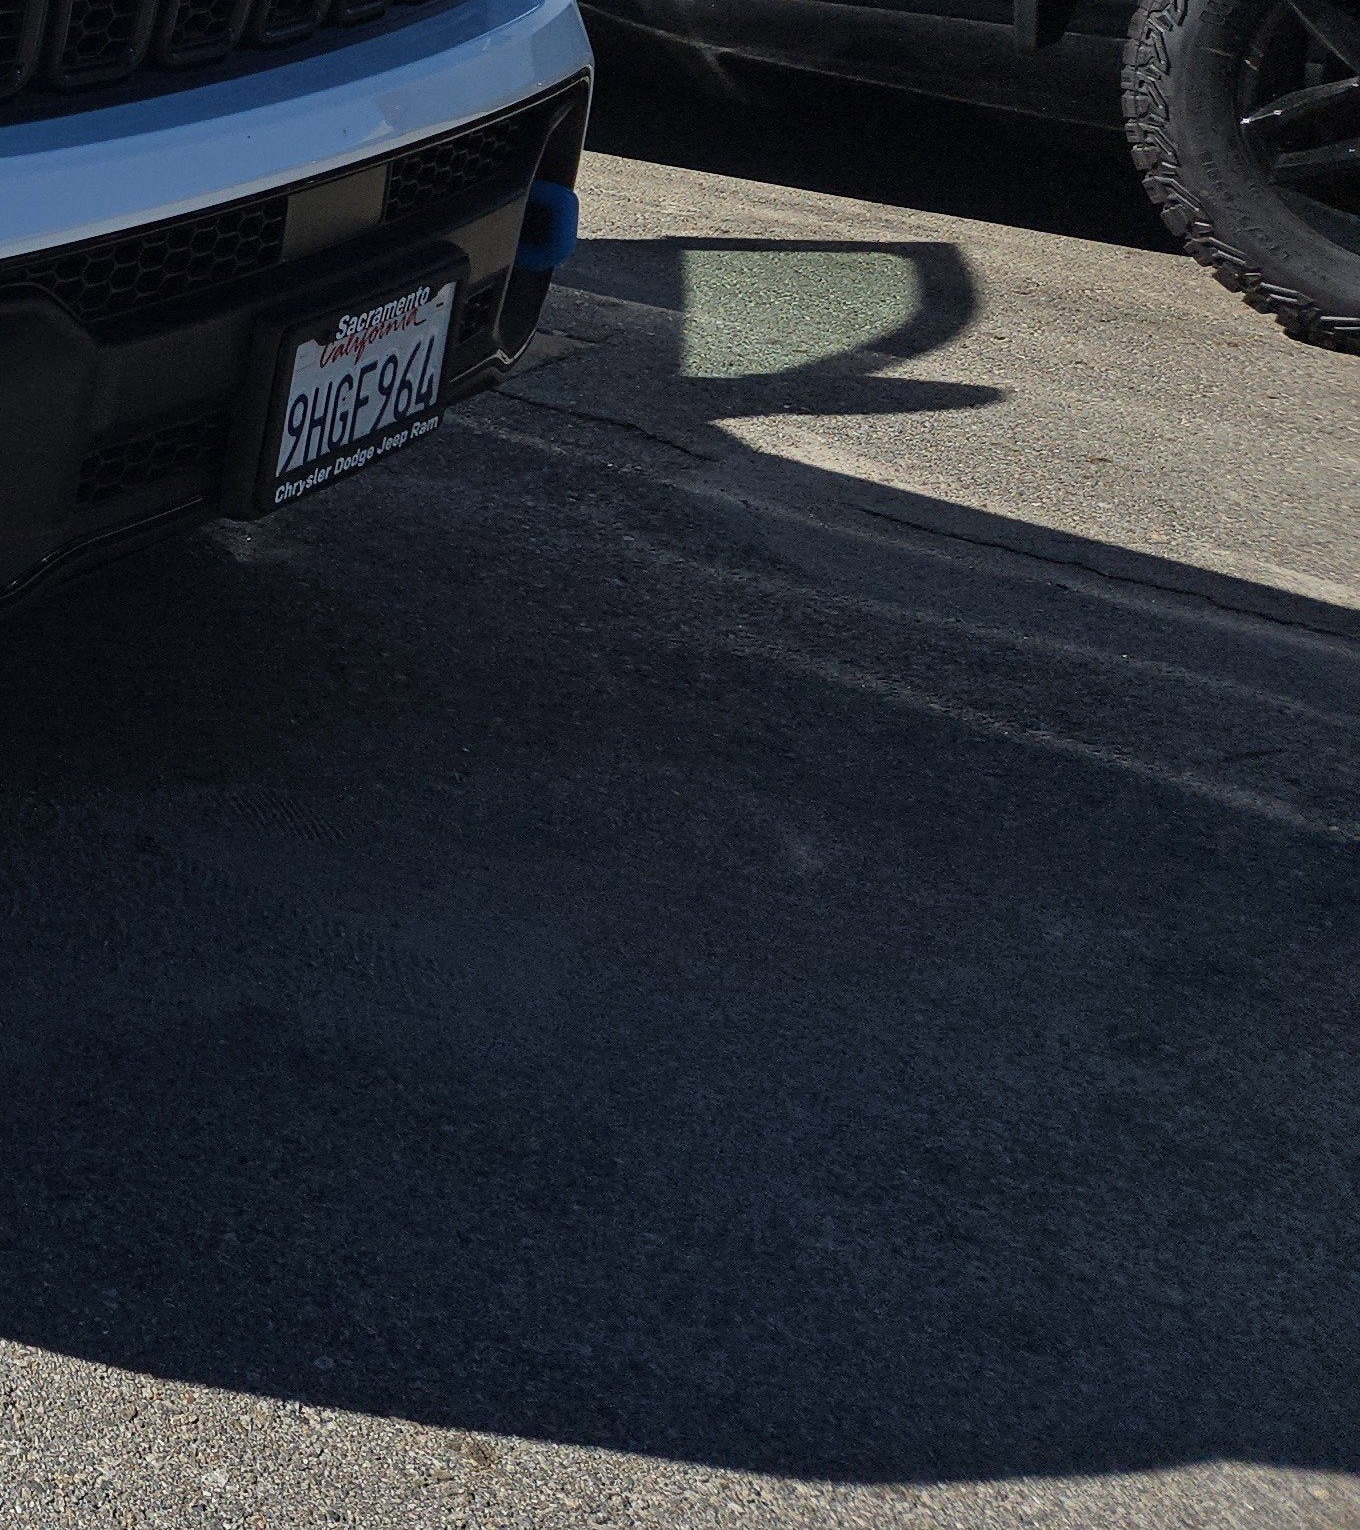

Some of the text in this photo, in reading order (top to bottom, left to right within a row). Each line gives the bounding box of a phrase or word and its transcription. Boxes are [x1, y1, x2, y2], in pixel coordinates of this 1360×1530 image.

[320, 307, 427, 368] California
[336, 285, 430, 340] Sacramento
[283, 336, 435, 471] 9HGF964
[275, 416, 439, 503] Chrysler Dodge Jeep Ram
